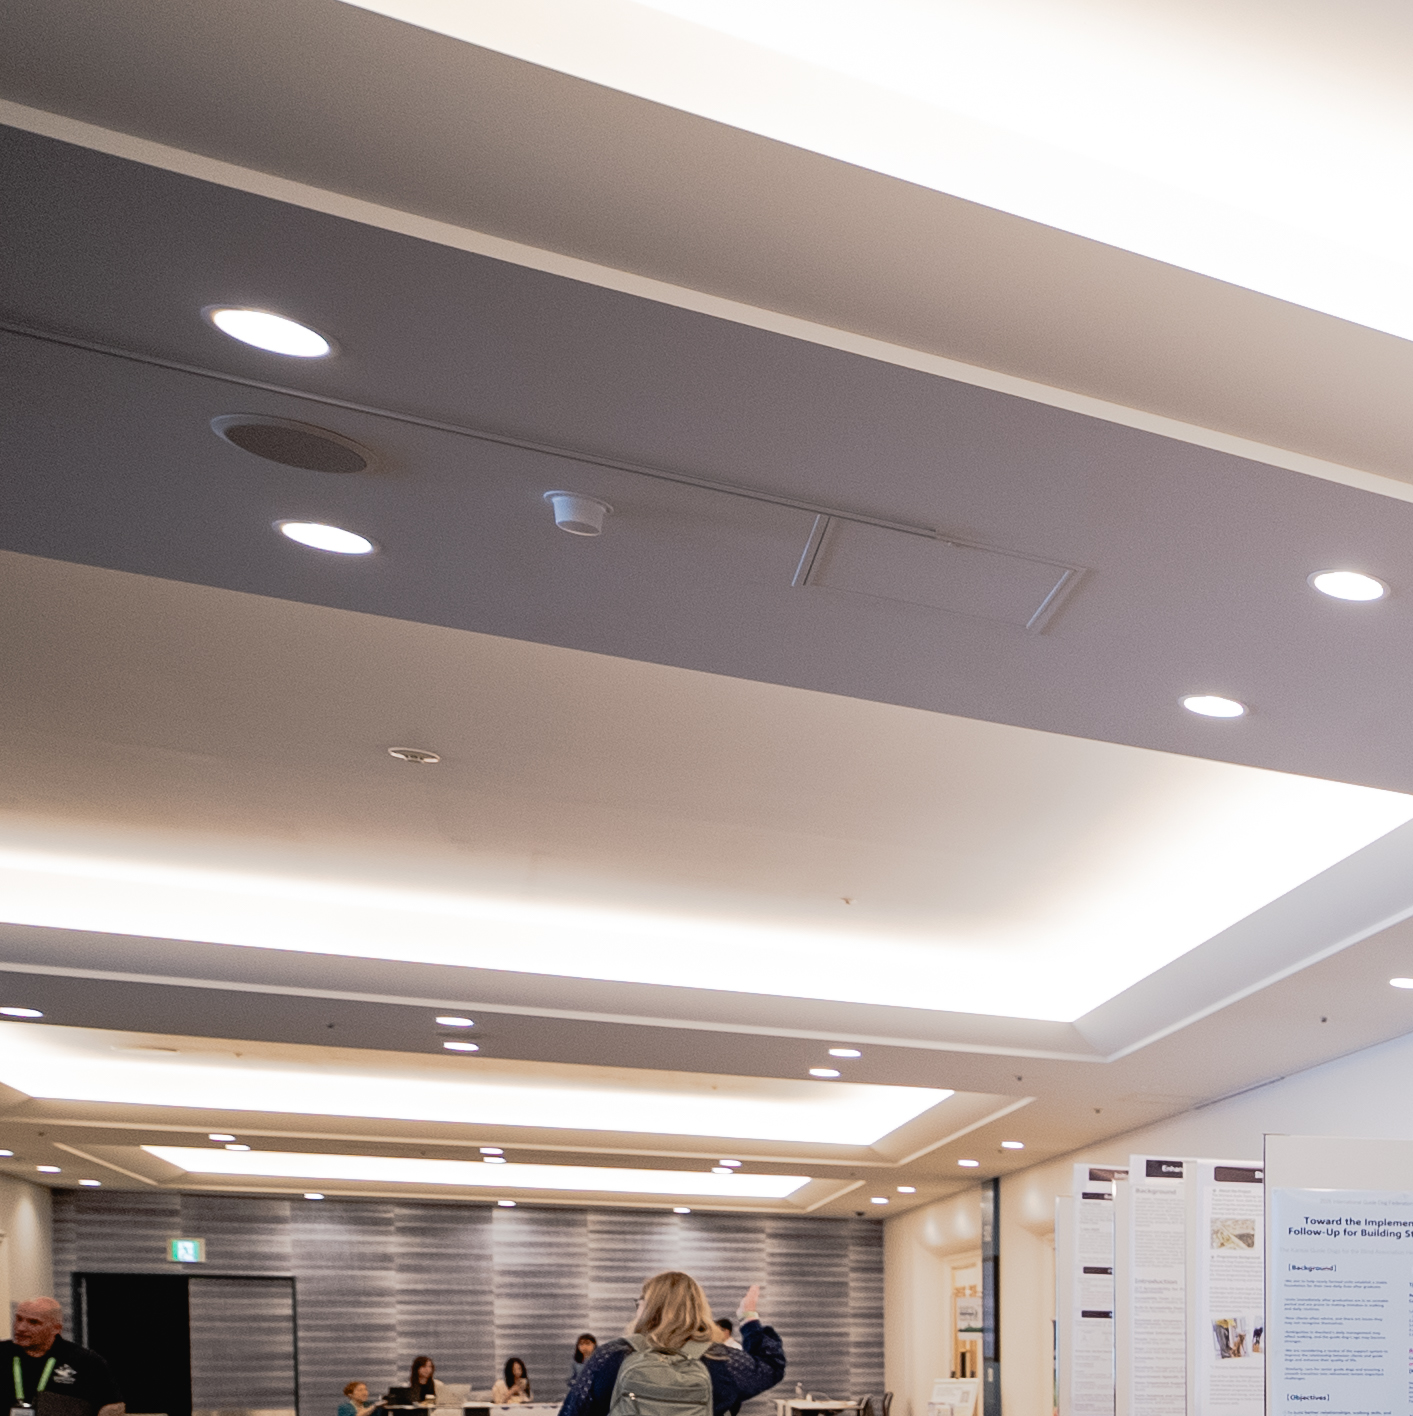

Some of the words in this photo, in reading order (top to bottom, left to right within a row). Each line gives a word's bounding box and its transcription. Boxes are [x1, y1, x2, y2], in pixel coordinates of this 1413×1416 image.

[1304, 1216, 1342, 1226] Toward
[1345, 1217, 1361, 1226] the
[1288, 1227, 1340, 1238] Follow-Up
[1343, 1227, 1358, 1237] for
[1361, 1229, 1402, 1239] Building
